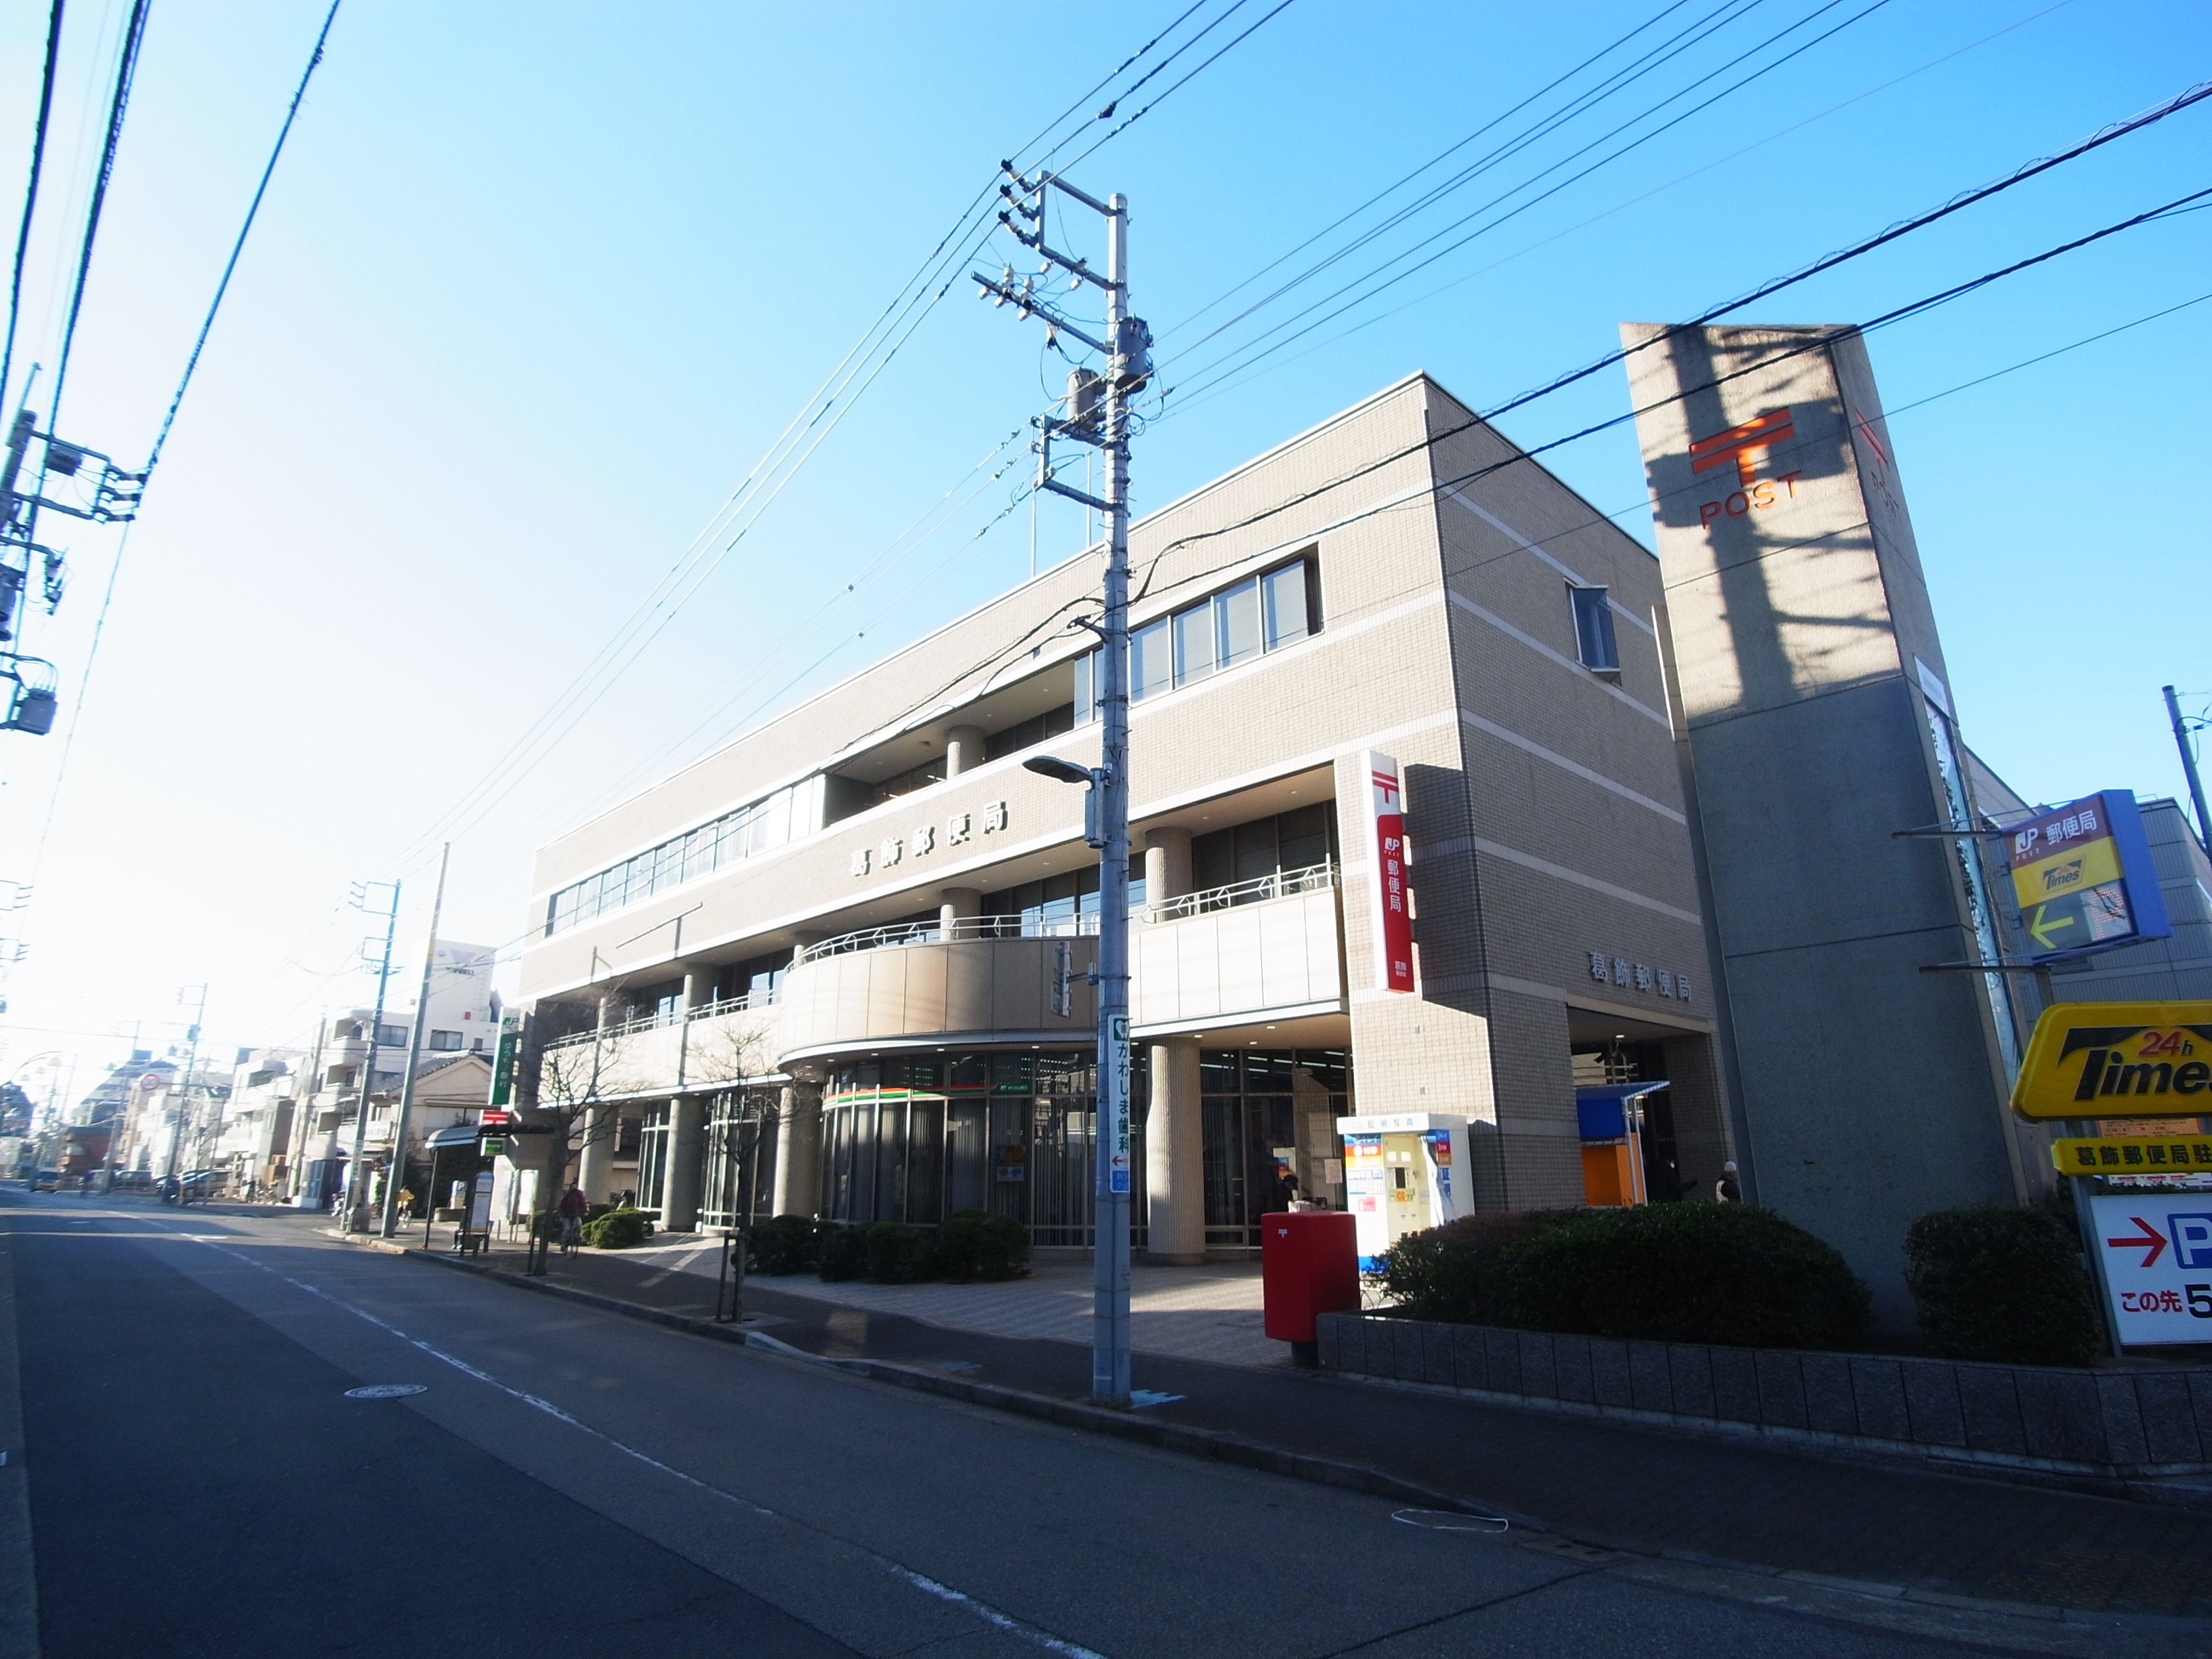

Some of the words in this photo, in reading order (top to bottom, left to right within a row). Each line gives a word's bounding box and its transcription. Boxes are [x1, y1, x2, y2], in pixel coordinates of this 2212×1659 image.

[1700, 470, 1802, 530] POST
[850, 800, 1009, 877] 葛飾郵便局
[1385, 836, 1400, 851] JP
[2015, 827, 2039, 854] JP
[2046, 810, 2097, 845] 郵便局
[2015, 848, 2040, 861] POST
[2042, 859, 2083, 890] Times
[1387, 859, 1401, 912] 郵便局
[1589, 951, 1692, 1003] 葛飾郵便局
[2057, 1025, 2212, 1101] Time
[2138, 1030, 2194, 1057] 24h
[1117, 1042, 1130, 1153] かわしま歯科
[1367, 1118, 1414, 1128] 証明写真
[2077, 1143, 2212, 1166] 葛飾郵便局駐
[2173, 1217, 2212, 1265] P
[2121, 1290, 2183, 1313] この先
